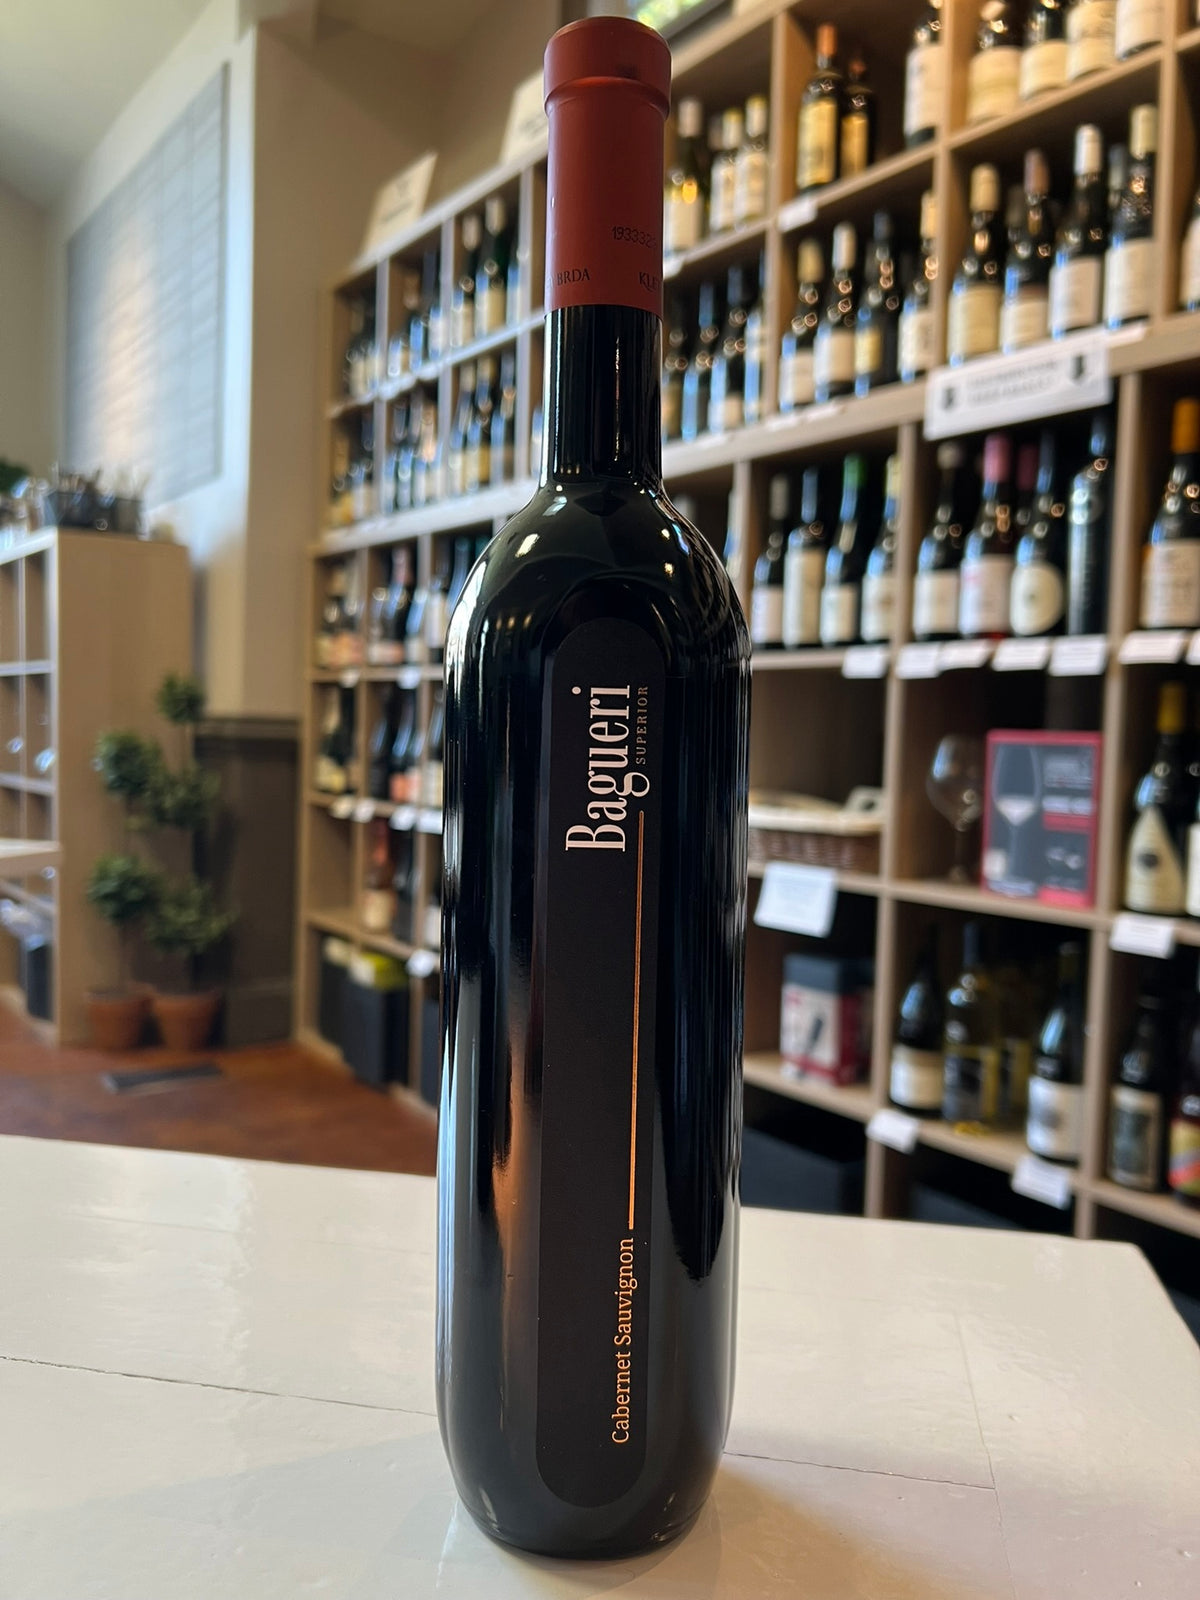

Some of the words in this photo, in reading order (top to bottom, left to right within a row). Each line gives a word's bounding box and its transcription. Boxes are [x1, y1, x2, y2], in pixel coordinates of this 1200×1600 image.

[557, 268, 590, 286] BRDA
[565, 685, 650, 852] Bagueri
[635, 686, 649, 765] SUPERIOR
[614, 1237, 638, 1346] Sauvignon
[612, 1351, 631, 1443] Cabernet
